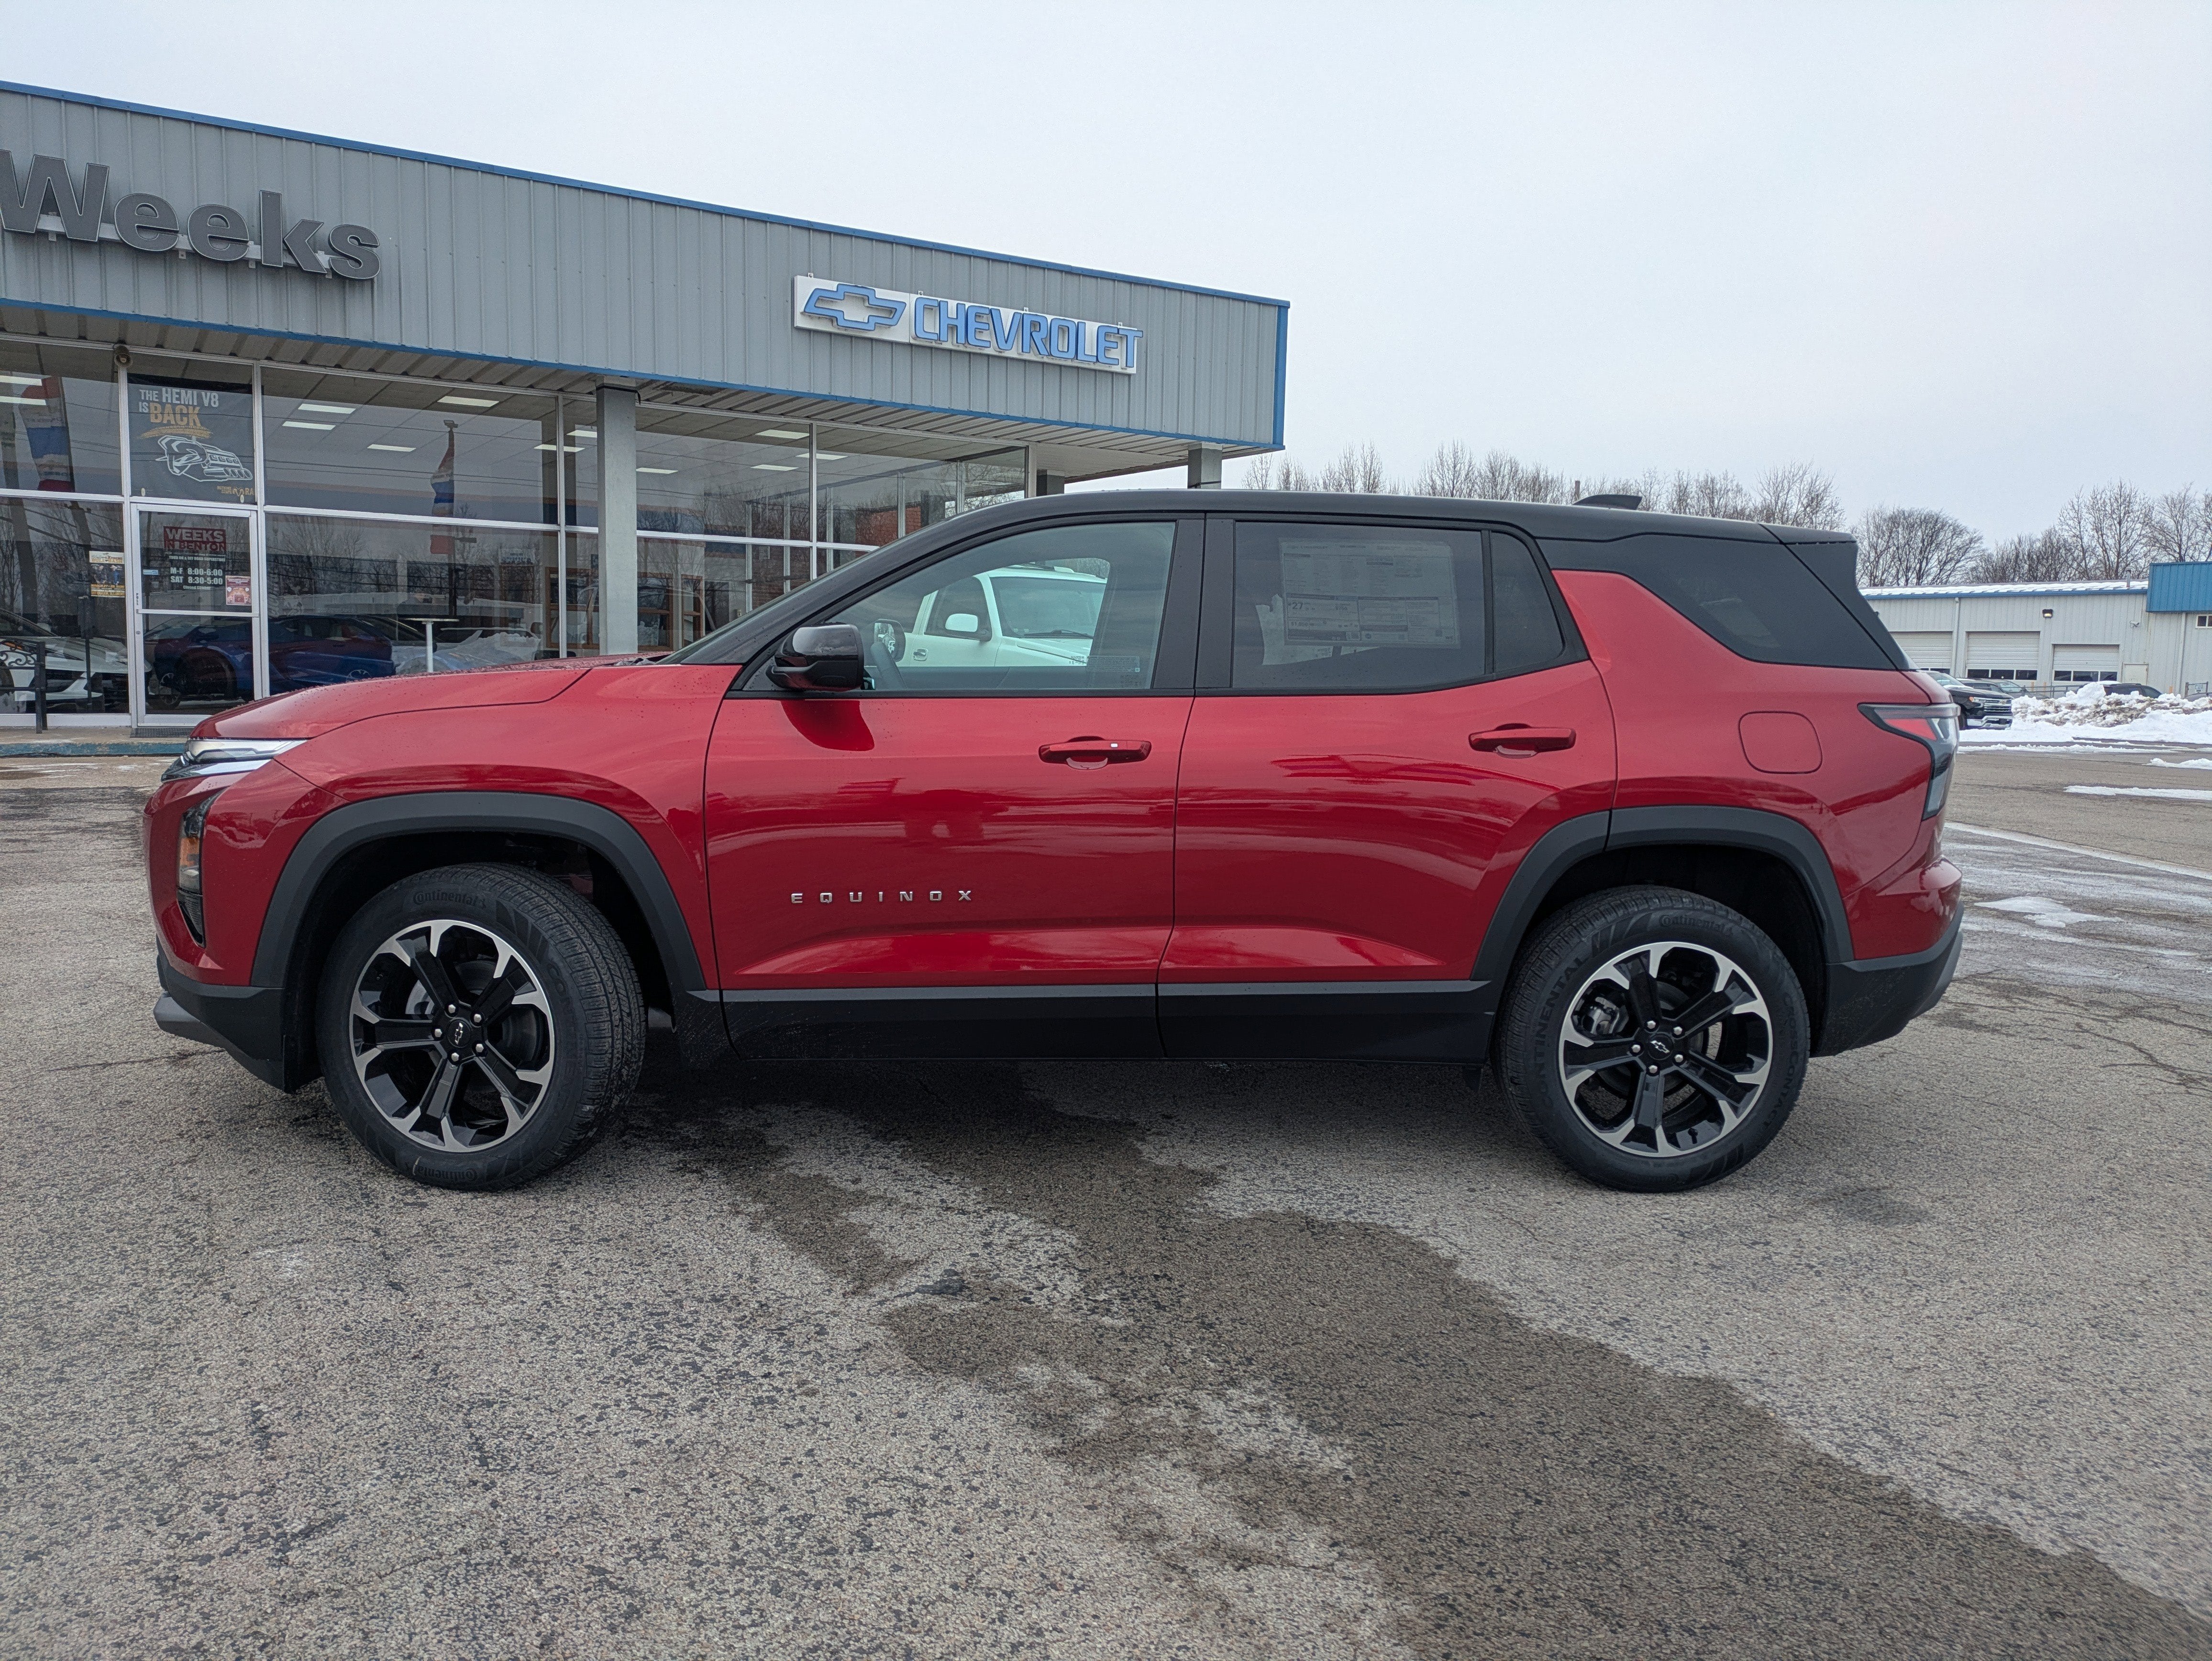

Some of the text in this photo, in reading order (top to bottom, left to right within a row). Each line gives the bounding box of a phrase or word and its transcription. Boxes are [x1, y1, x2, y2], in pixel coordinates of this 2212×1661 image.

[0, 149, 381, 280] Weeks
[914, 297, 1144, 368] CHEVROLET
[139, 388, 219, 407] THE HEMI V8
[139, 402, 201, 426] IS BACK
[166, 528, 224, 543] WEEKS
[164, 541, 226, 552] IN BENTON
[188, 567, 223, 576] 8:00-6:00
[188, 576, 223, 585] 8:30-5:00
[1292, 601, 1303, 609] 27
[413, 889, 479, 906] Continental
[791, 890, 972, 904] EQUINOX
[1535, 957, 1588, 1107] CONTINENTAL
